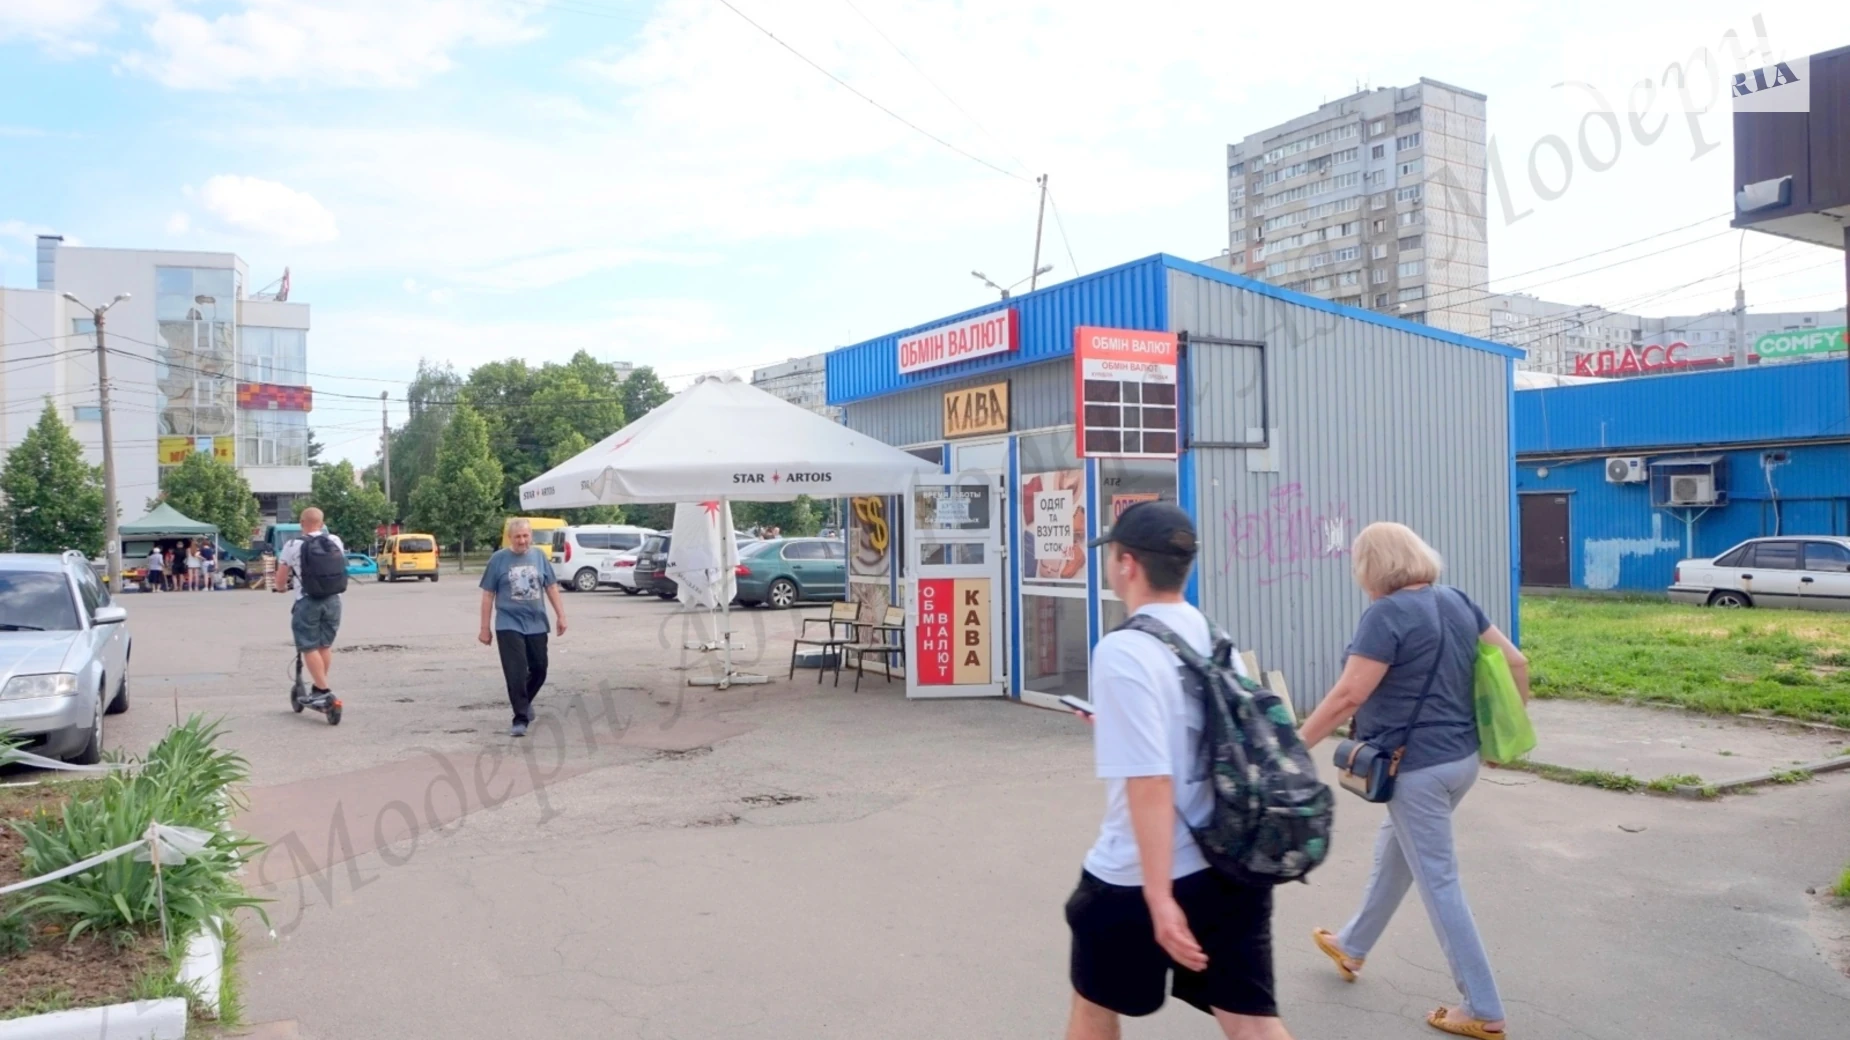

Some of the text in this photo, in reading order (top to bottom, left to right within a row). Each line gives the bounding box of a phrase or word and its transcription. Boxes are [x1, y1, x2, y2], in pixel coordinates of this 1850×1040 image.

[900, 317, 1005, 368] ОБМІН ВАЛЮТ
[1092, 336, 1172, 354] ОБМІН ВАЛЮТ
[1758, 330, 1842, 354] COMFY
[1101, 361, 1158, 372] ОБМІН ВАЛЮТ
[1574, 341, 1689, 376] КЛАСС
[946, 388, 1005, 432] КАВА
[733, 472, 832, 484] STAR ARTOIS
[1040, 497, 1065, 512] ОДЯГ
[1049, 513, 1058, 522] ТА
[1036, 525, 1071, 537] ВЗУТТЯ
[1043, 543, 1063, 552] СТОК
[923, 587, 935, 650] ОБМІН
[964, 590, 981, 667] КАВА
[937, 613, 949, 677] ВАЛЮТ
